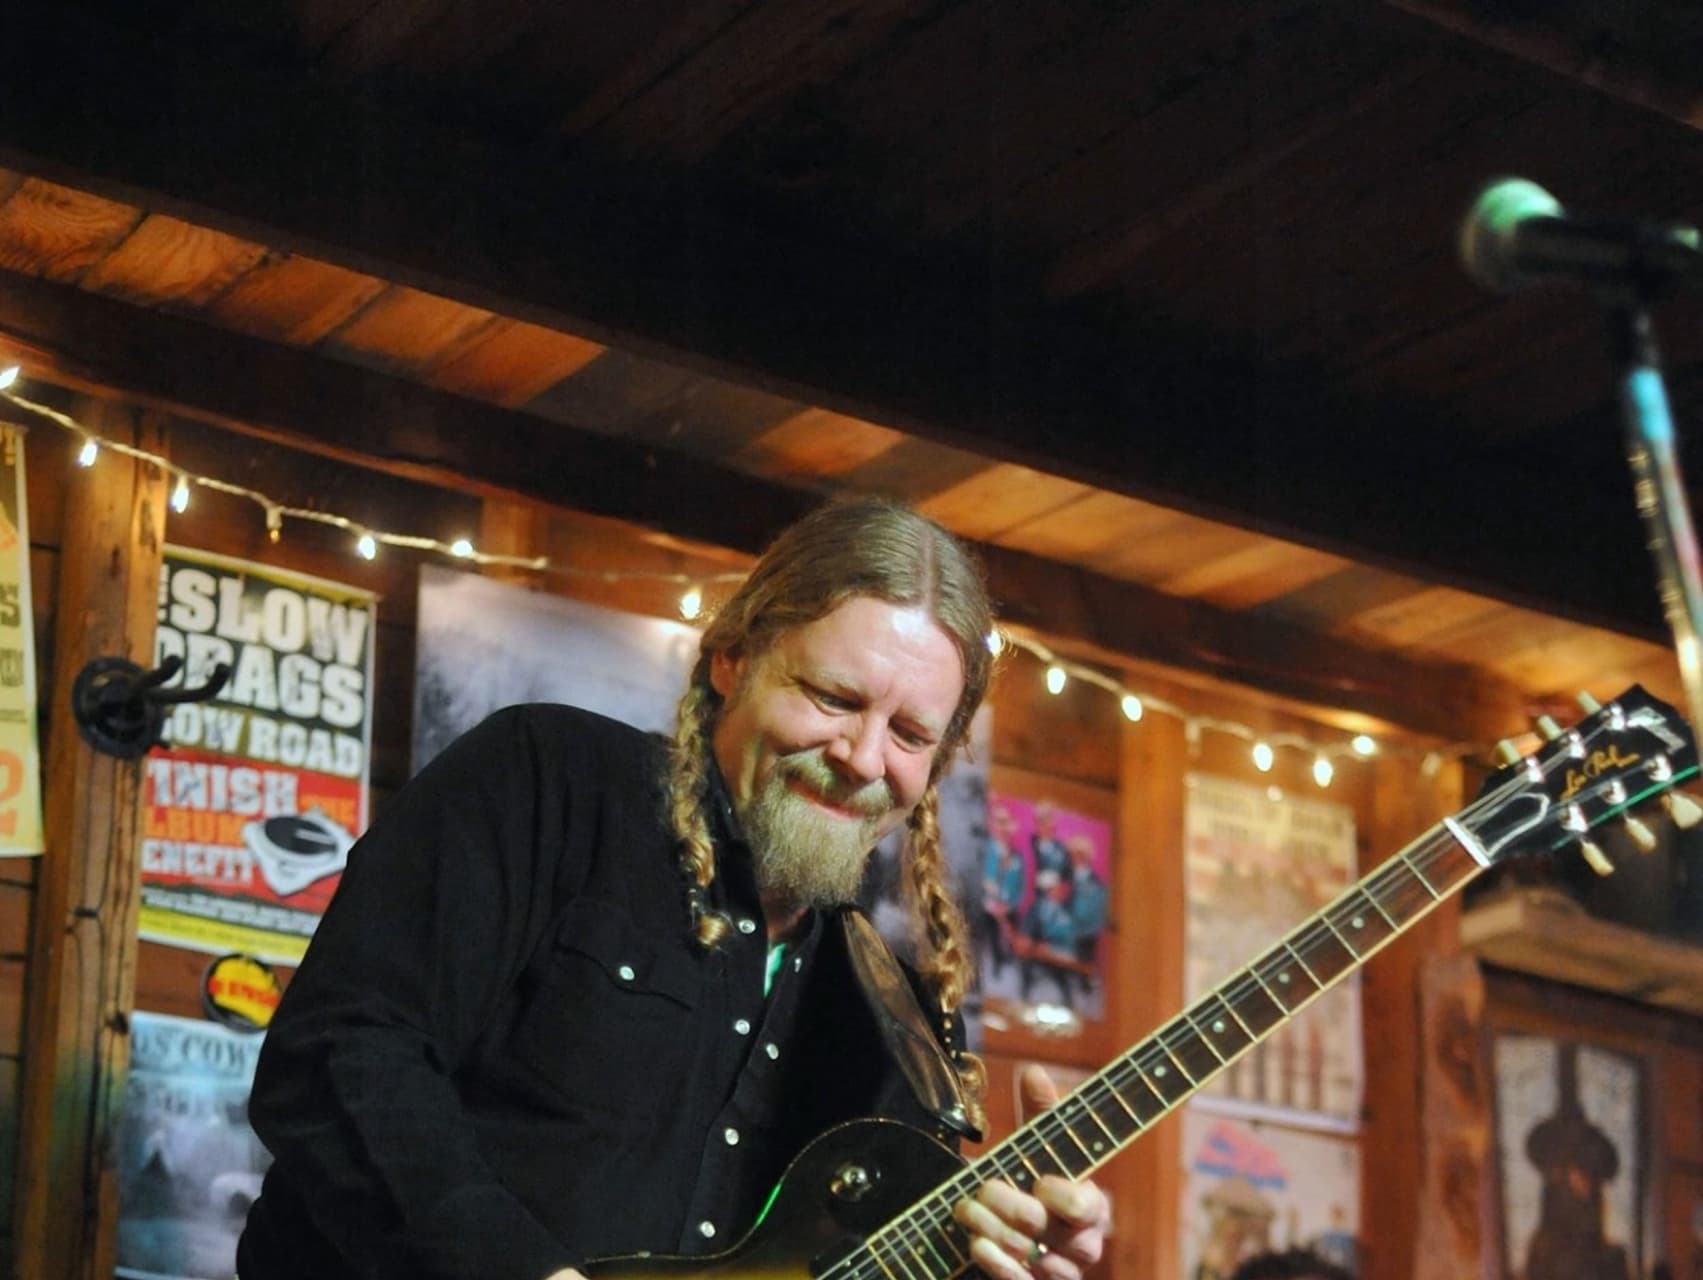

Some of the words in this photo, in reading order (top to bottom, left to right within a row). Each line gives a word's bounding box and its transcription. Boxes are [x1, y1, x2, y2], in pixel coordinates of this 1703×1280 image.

[170, 567, 369, 668] SLOW
[153, 625, 365, 729] DRAGS
[247, 715, 363, 778] ROAD
[147, 757, 299, 818] INISH
[142, 839, 255, 883] ENEFIT
